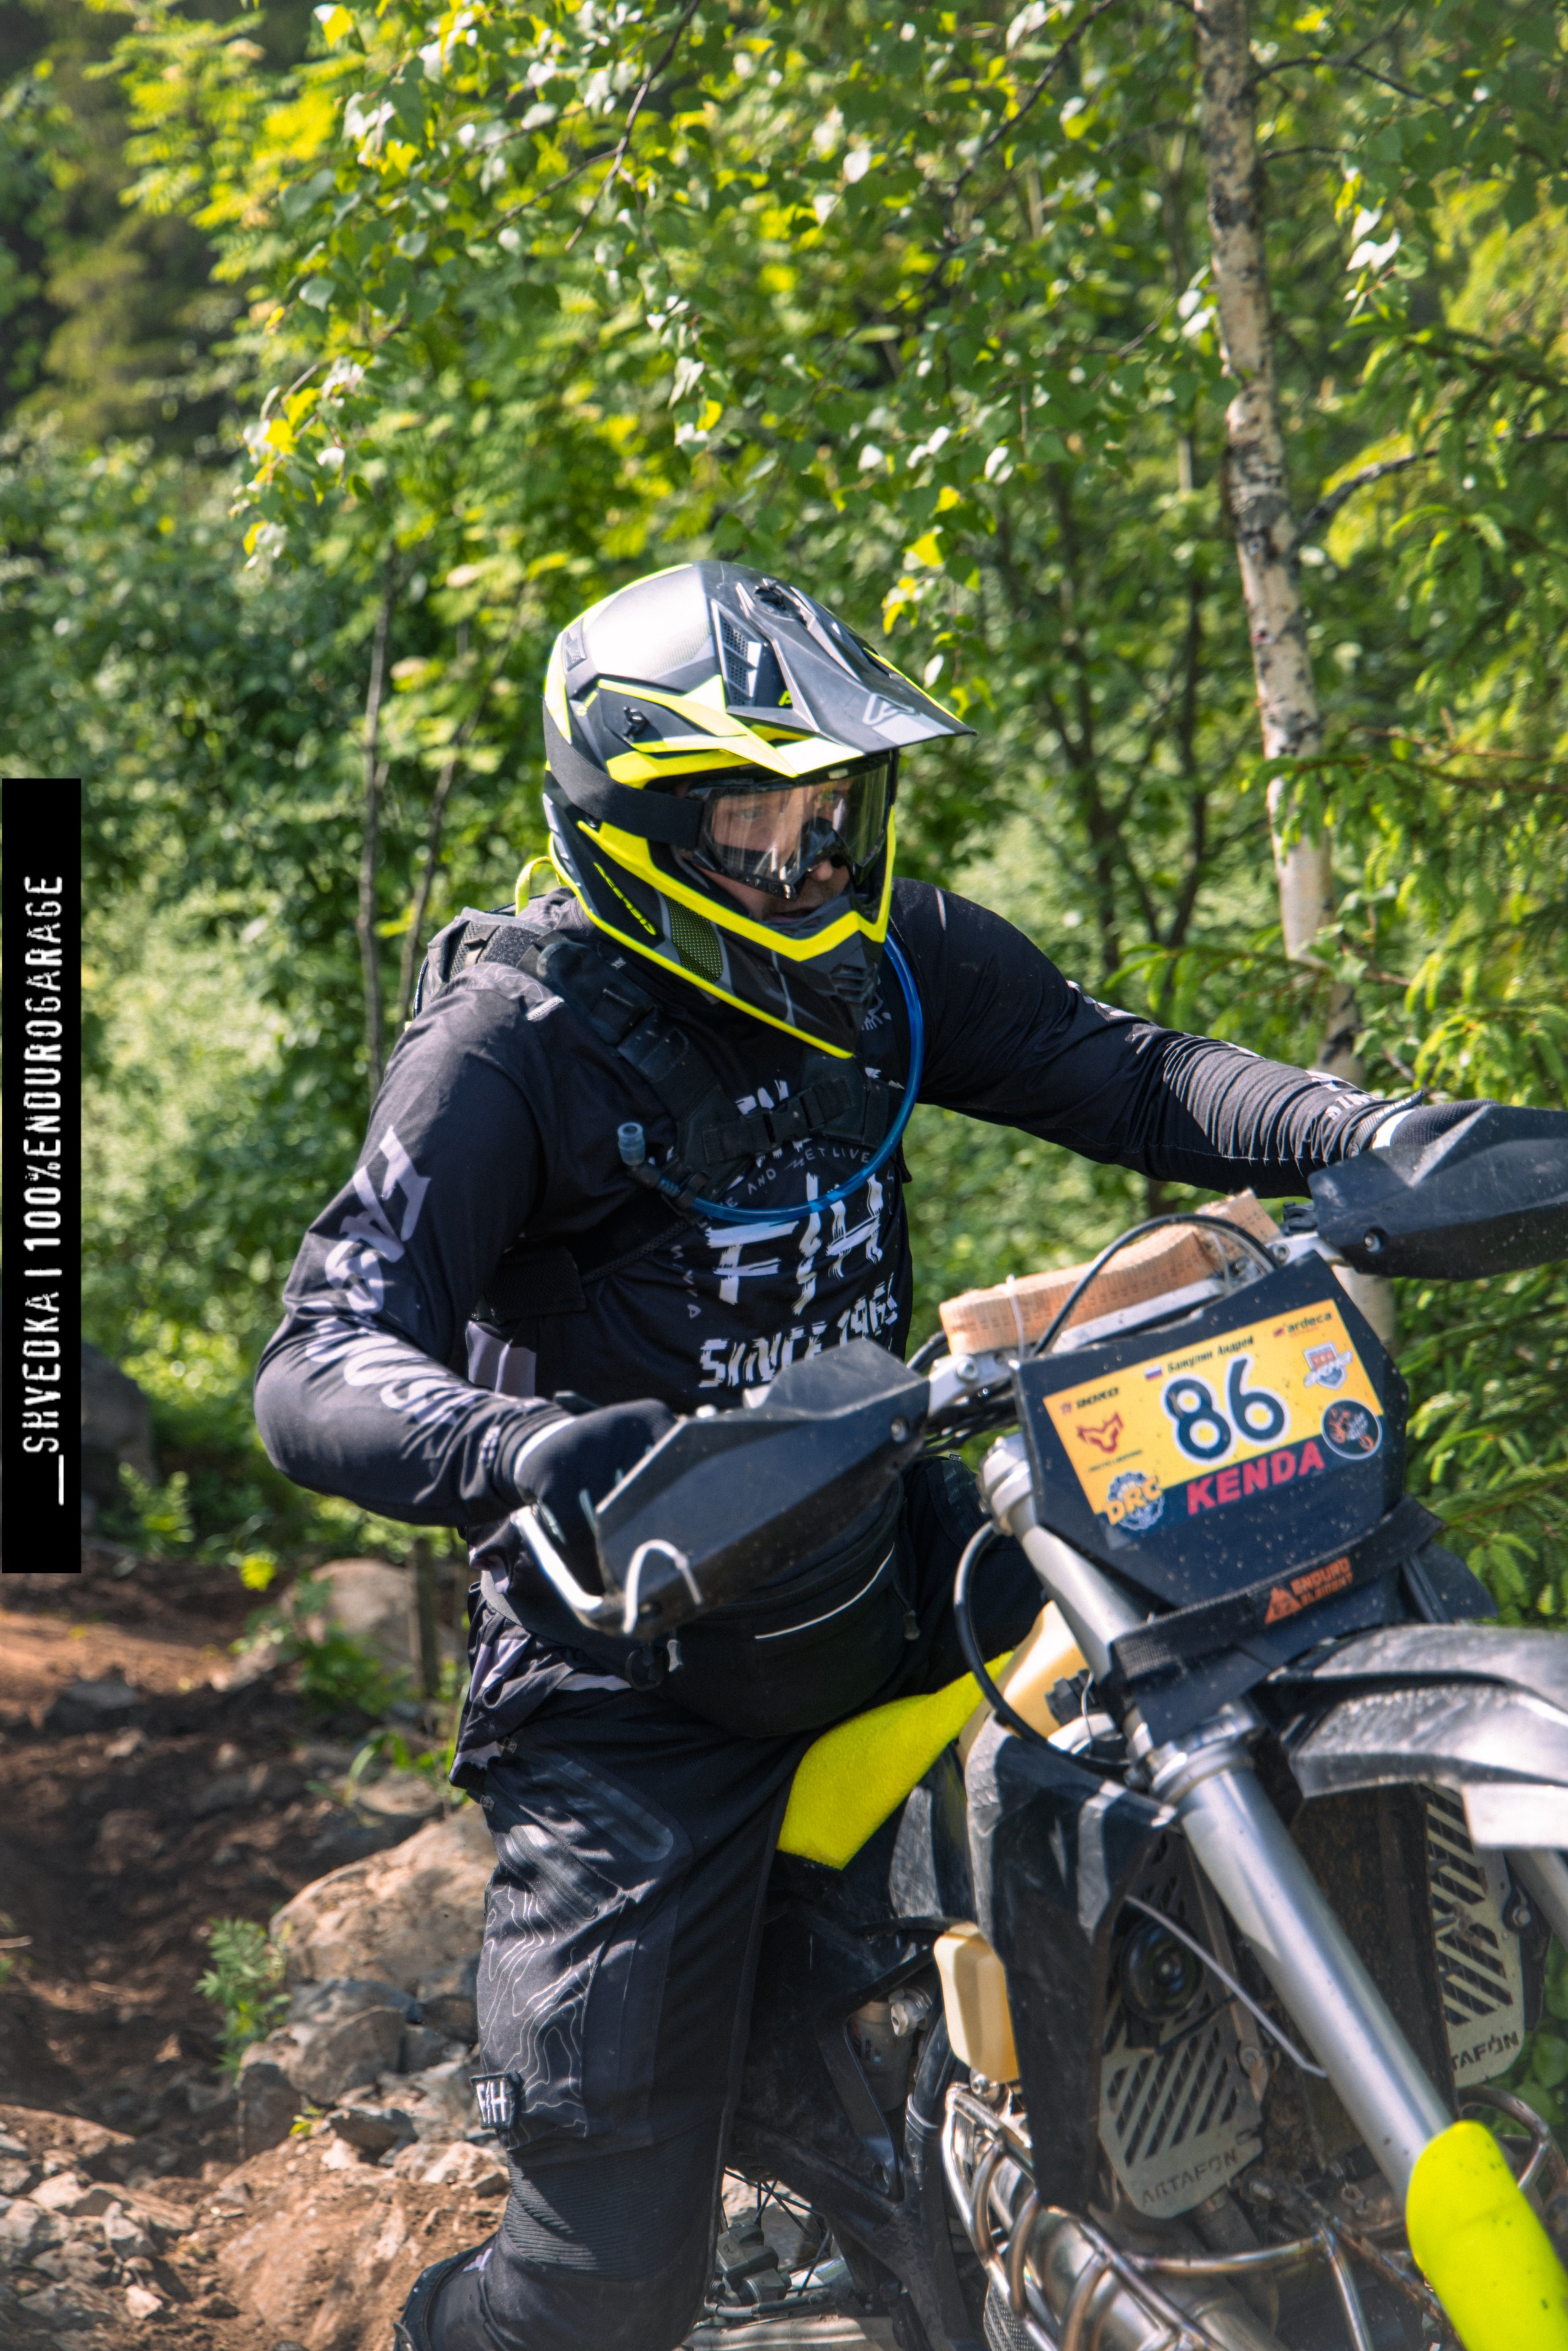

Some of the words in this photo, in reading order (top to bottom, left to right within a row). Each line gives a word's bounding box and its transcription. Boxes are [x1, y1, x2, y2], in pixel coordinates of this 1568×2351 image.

[1163, 1355, 1288, 1462] 86
[1104, 1475, 1162, 1525] DRC
[1186, 1441, 1325, 1515] KENDA
[1142, 2148, 1238, 2206] ARTAFON
